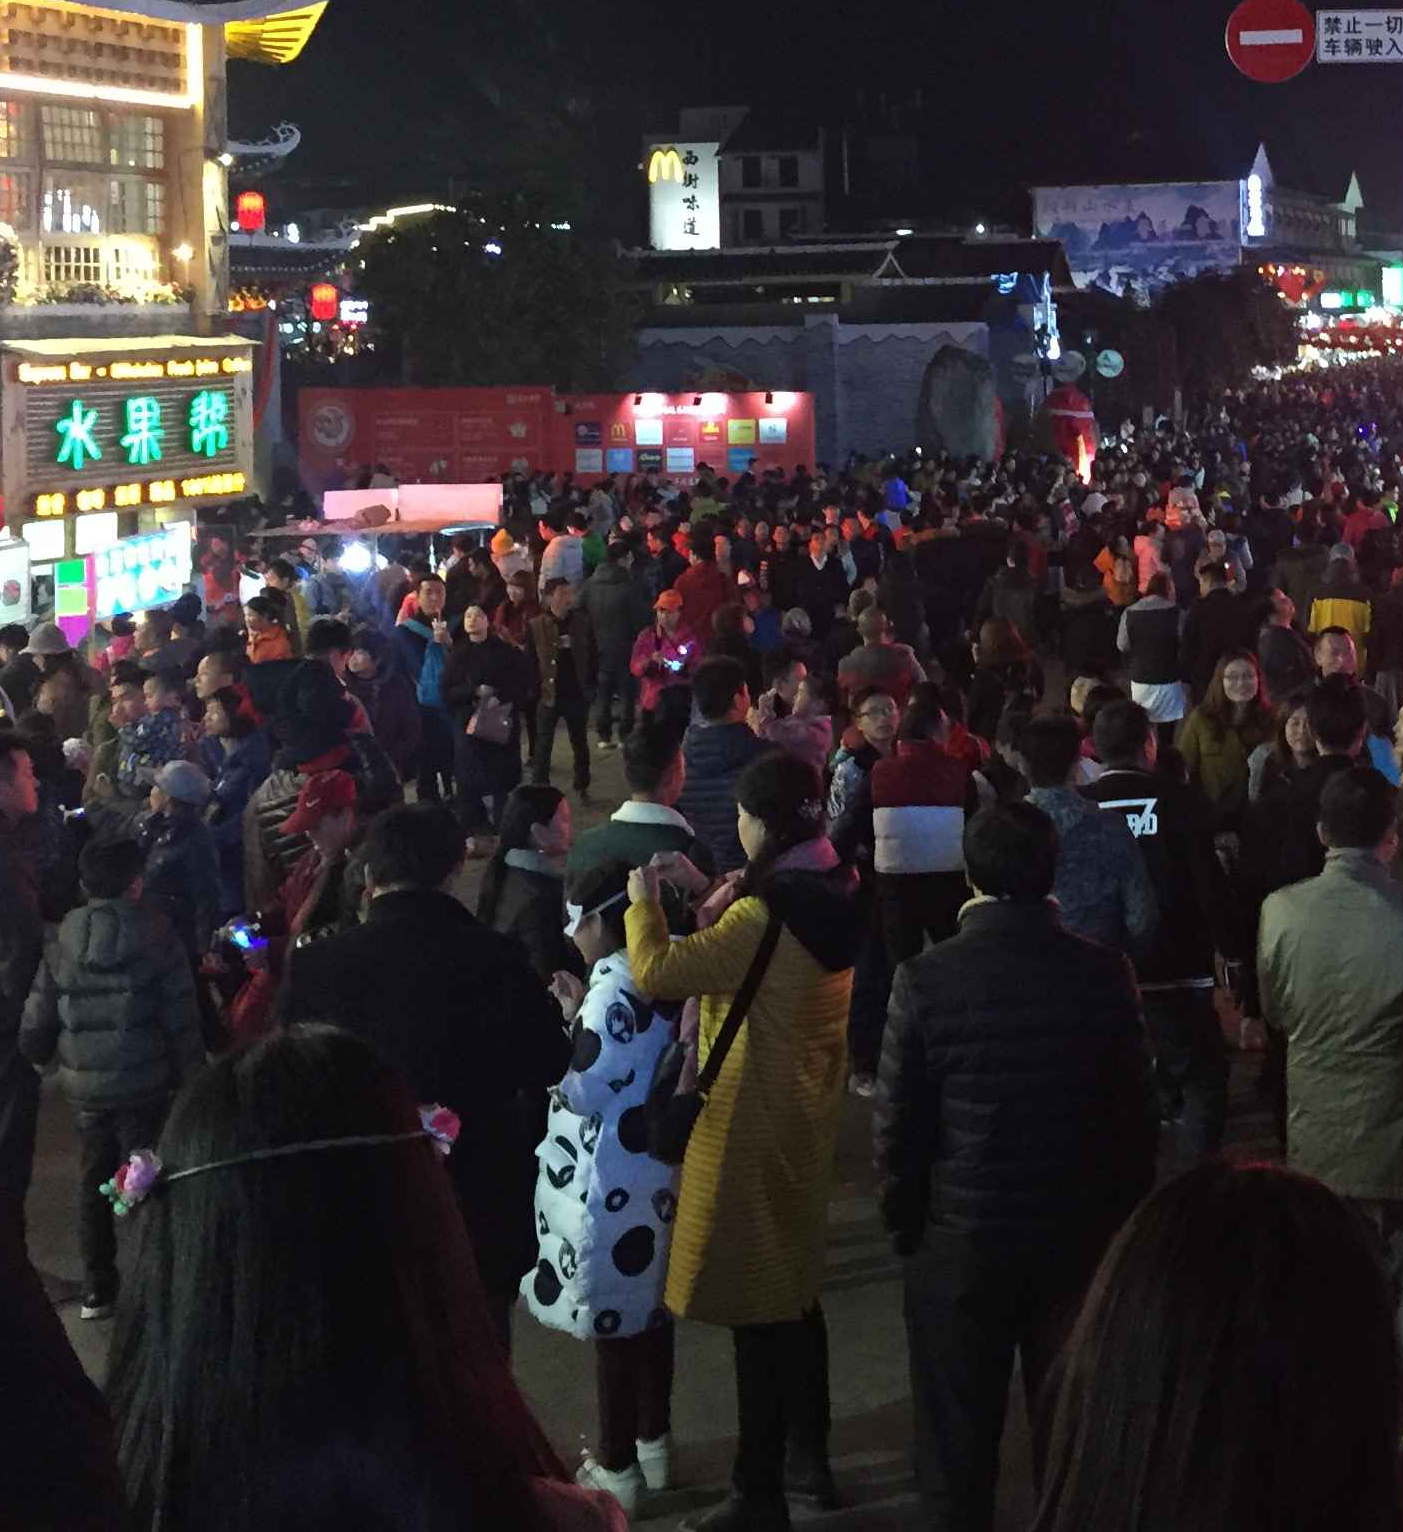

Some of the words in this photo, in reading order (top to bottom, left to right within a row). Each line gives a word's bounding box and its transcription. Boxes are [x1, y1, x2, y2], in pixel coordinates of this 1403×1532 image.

[1324, 16, 1403, 35] 禁止一切
[1324, 38, 1403, 56] 车辆驶入
[682, 150, 700, 235] 西街味道
[56, 391, 229, 470] 水果帮
